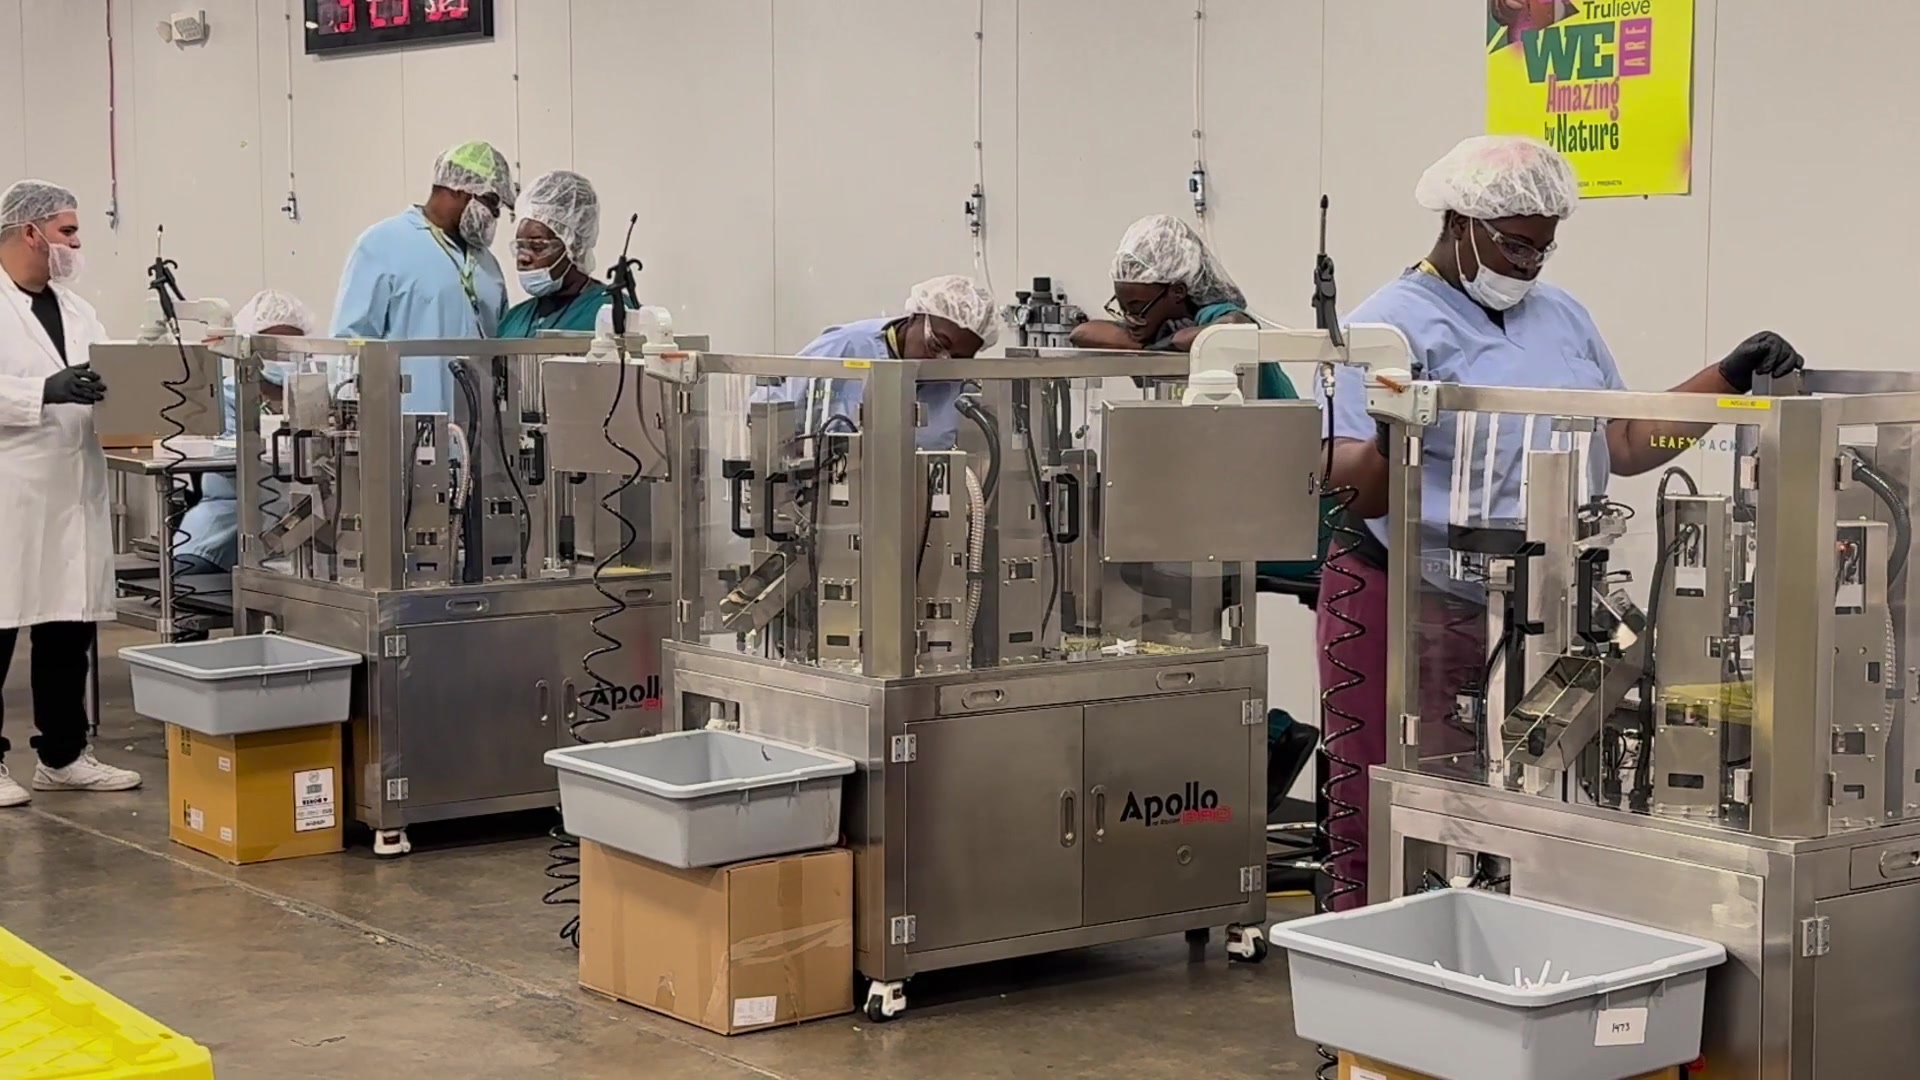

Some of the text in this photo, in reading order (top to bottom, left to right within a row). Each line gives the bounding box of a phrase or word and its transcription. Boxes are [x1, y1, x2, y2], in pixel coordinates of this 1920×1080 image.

[1583, 0, 1651, 19] Trulieve
[1521, 21, 1647, 83] WE ARE
[1546, 75, 1620, 121] Amazing
[1544, 113, 1619, 153] by Nature
[589, 675, 663, 711] Apoll
[1120, 781, 1219, 827] Apollo
